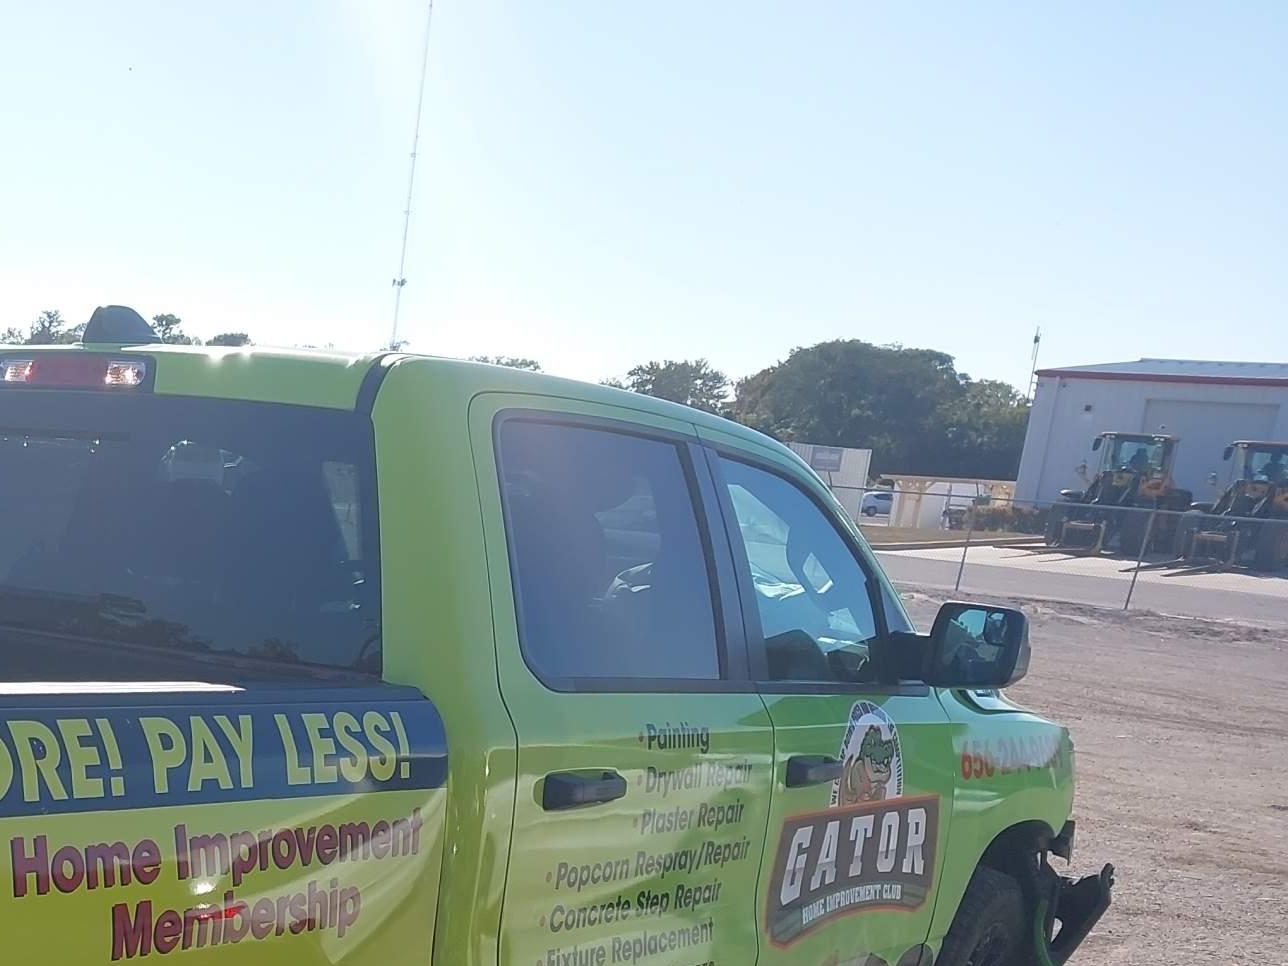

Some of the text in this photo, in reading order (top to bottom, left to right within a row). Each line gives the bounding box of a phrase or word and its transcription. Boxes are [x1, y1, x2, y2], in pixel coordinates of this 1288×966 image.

[139, 715, 254, 794] PAY
[273, 711, 410, 785] LESS!
[646, 722, 710, 753] Painting
[646, 759, 752, 798] Drywall Repair
[640, 799, 745, 835] Plaster Repair
[10, 807, 423, 898] Home Improvement
[555, 836, 751, 892] Popcorn Respray/Repair
[780, 808, 926, 906] GATOR
[111, 877, 361, 962] Membership
[549, 878, 722, 933] Concrete Step Repair
[802, 884, 902, 925] HOME IMPROVEMENT CLUB
[612, 917, 714, 965] Replacement
